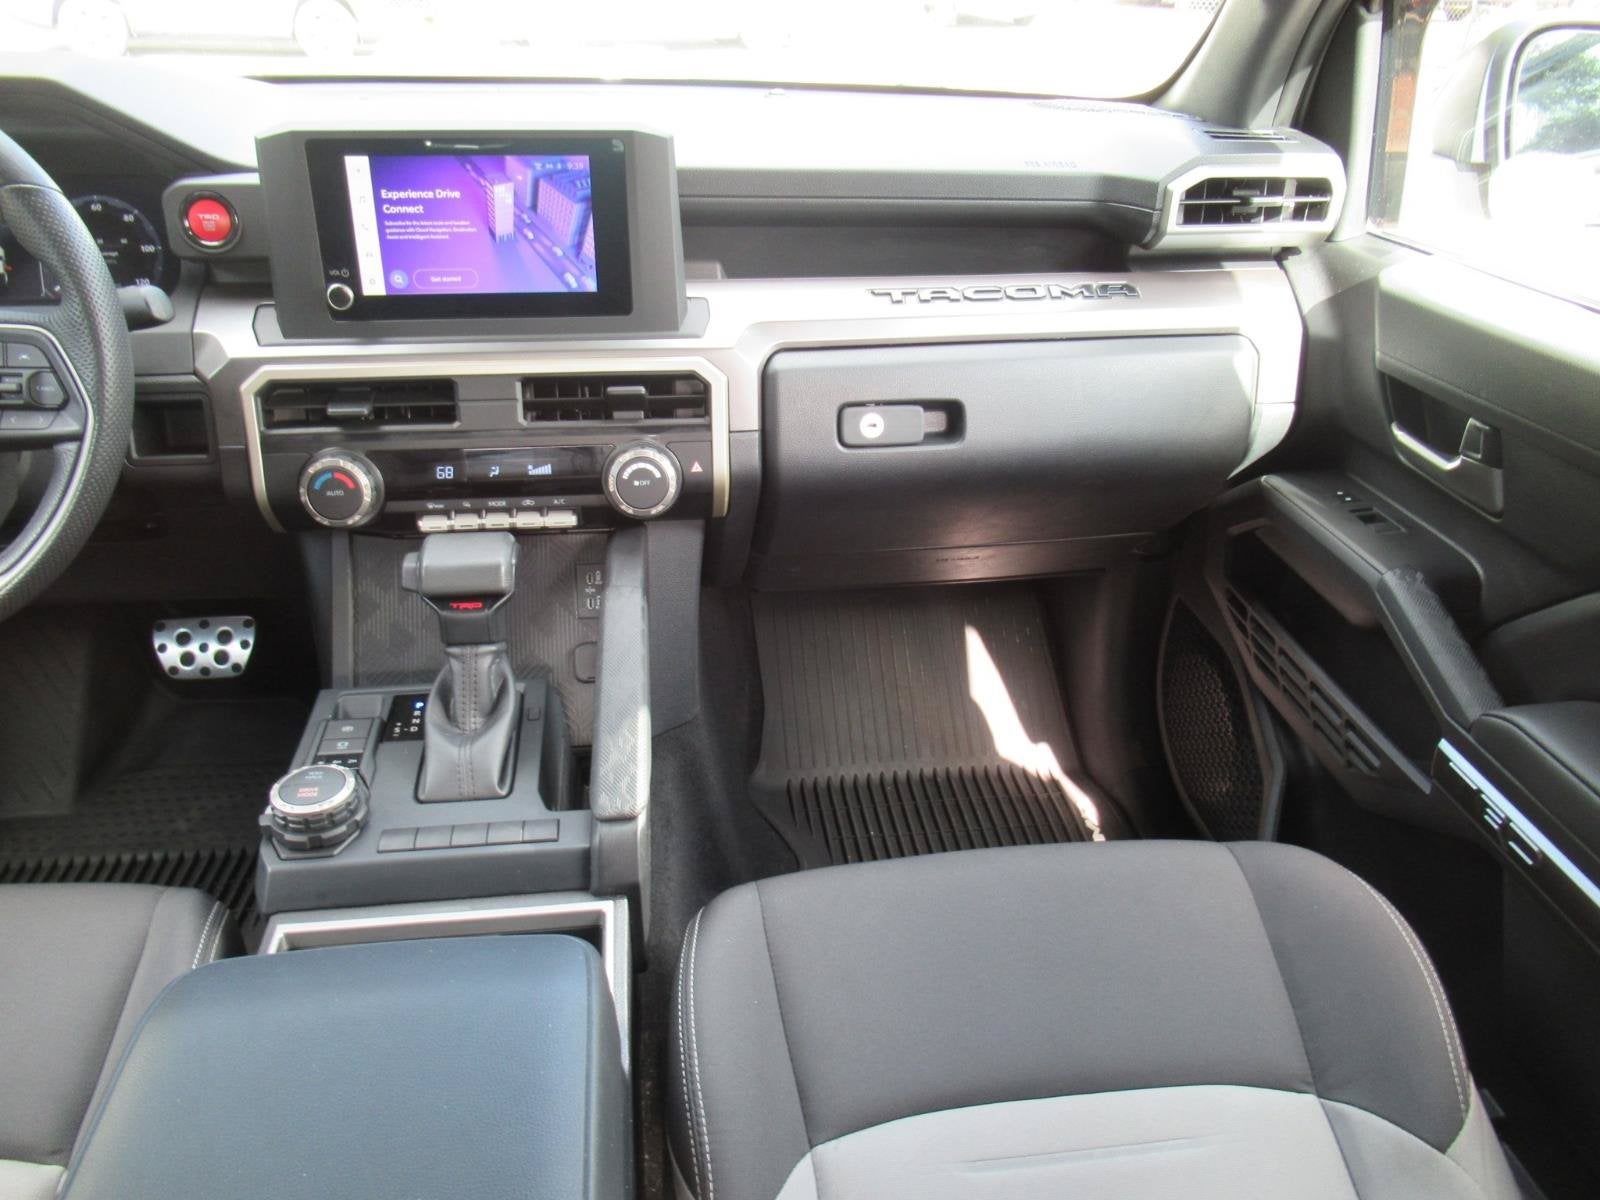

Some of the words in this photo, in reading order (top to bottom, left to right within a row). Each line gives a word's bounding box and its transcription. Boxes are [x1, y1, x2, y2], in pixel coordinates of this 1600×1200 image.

[381, 189, 434, 200] Experience
[435, 189, 461, 199] Drive
[90, 203, 102, 211] 60
[383, 204, 424, 214] Connect
[122, 214, 135, 222] 80
[141, 244, 156, 253] 100
[868, 280, 1140, 305] TACOMA
[436, 466, 454, 480] 68
